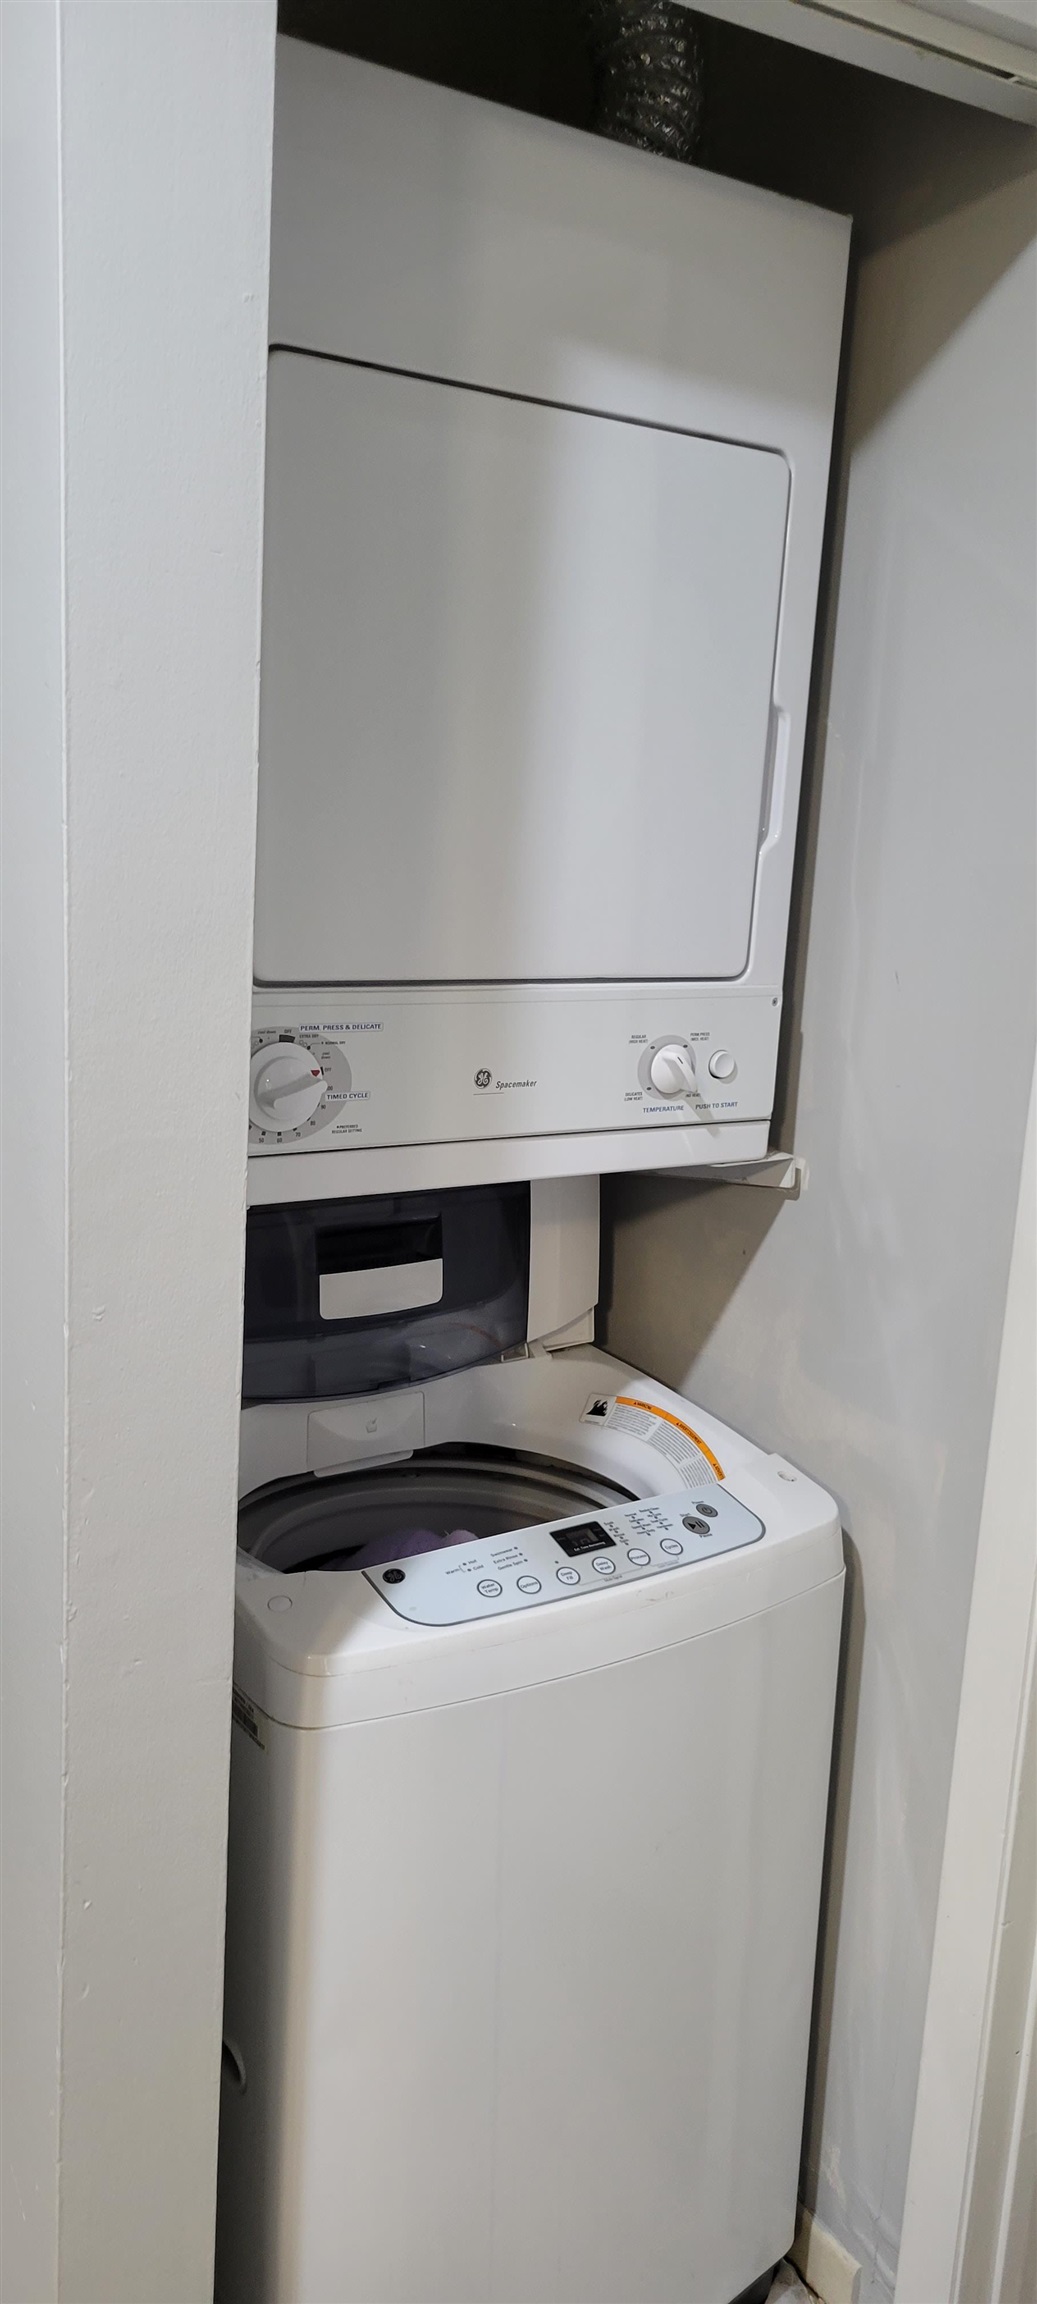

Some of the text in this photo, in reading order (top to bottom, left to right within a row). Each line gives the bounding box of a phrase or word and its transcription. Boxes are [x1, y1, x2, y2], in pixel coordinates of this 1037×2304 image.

[496, 1080, 537, 1090] Spacemaker
[643, 1105, 684, 1113] TEMPERATURE
[520, 1581, 538, 1589] Options
